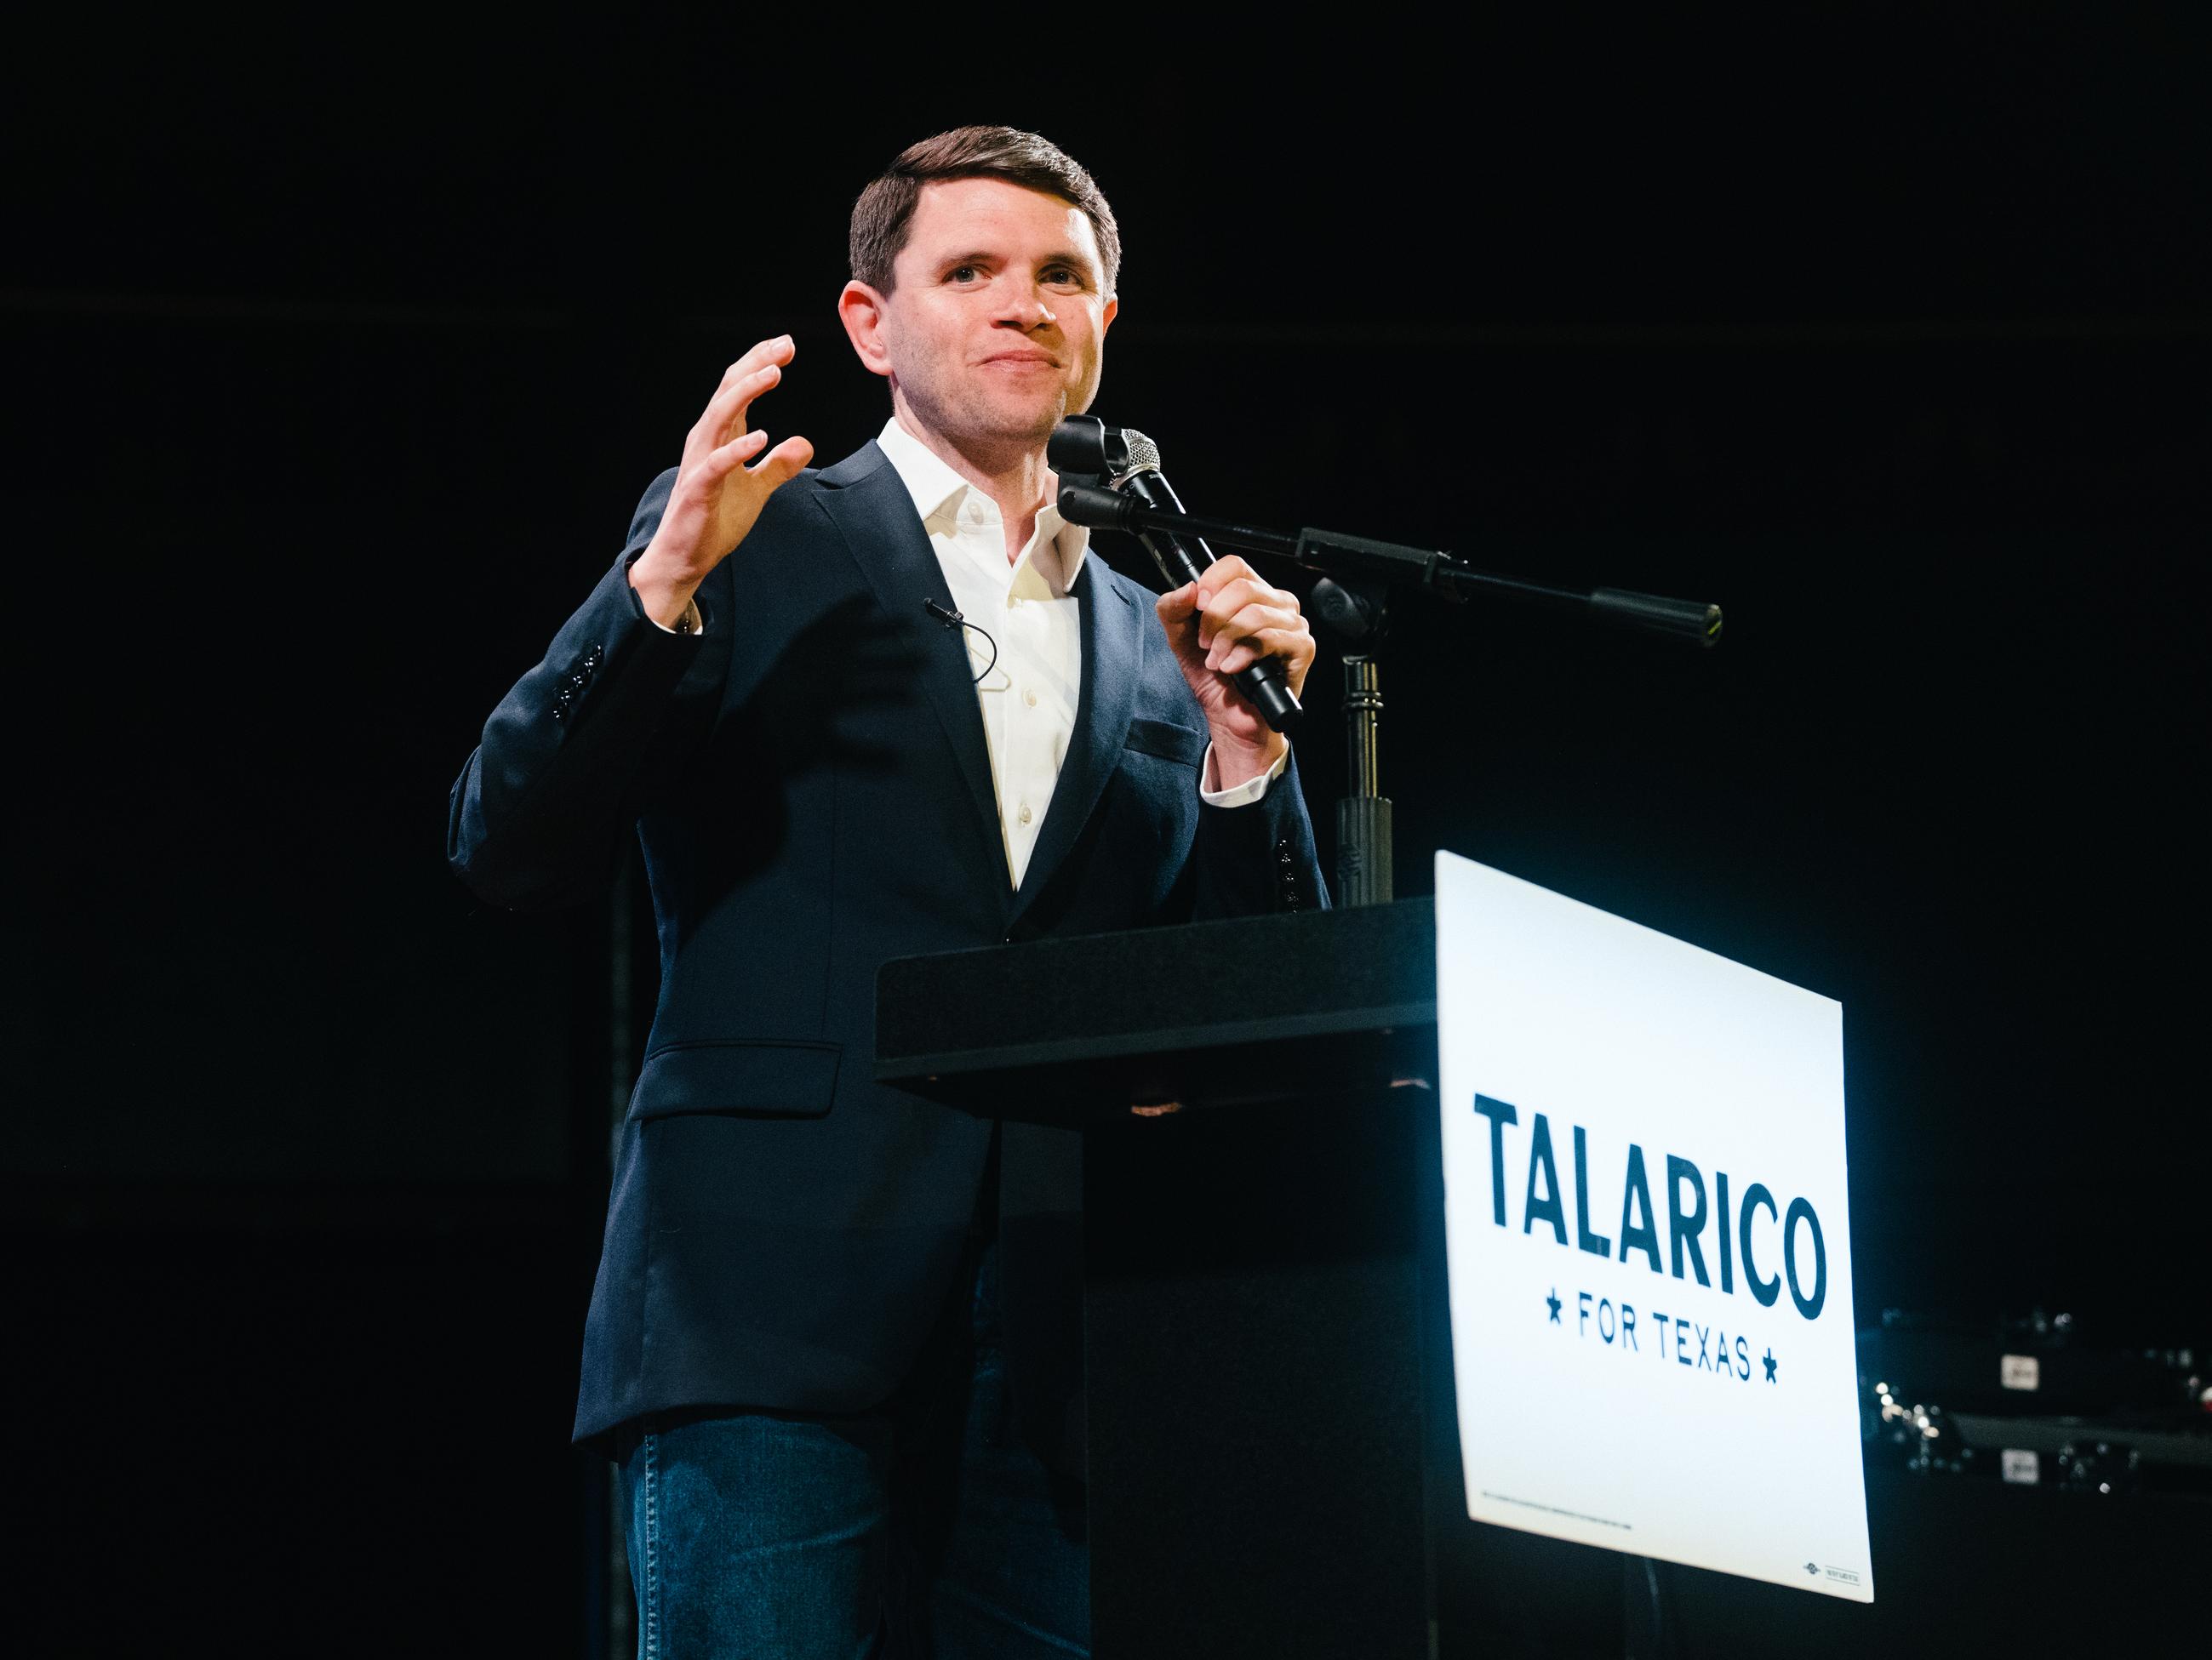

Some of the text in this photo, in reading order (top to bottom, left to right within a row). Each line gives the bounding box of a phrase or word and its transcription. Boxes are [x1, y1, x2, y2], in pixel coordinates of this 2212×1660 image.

[1474, 1093, 1826, 1320] TALARICO
[1579, 1292, 1751, 1381] FOR TEXAS
